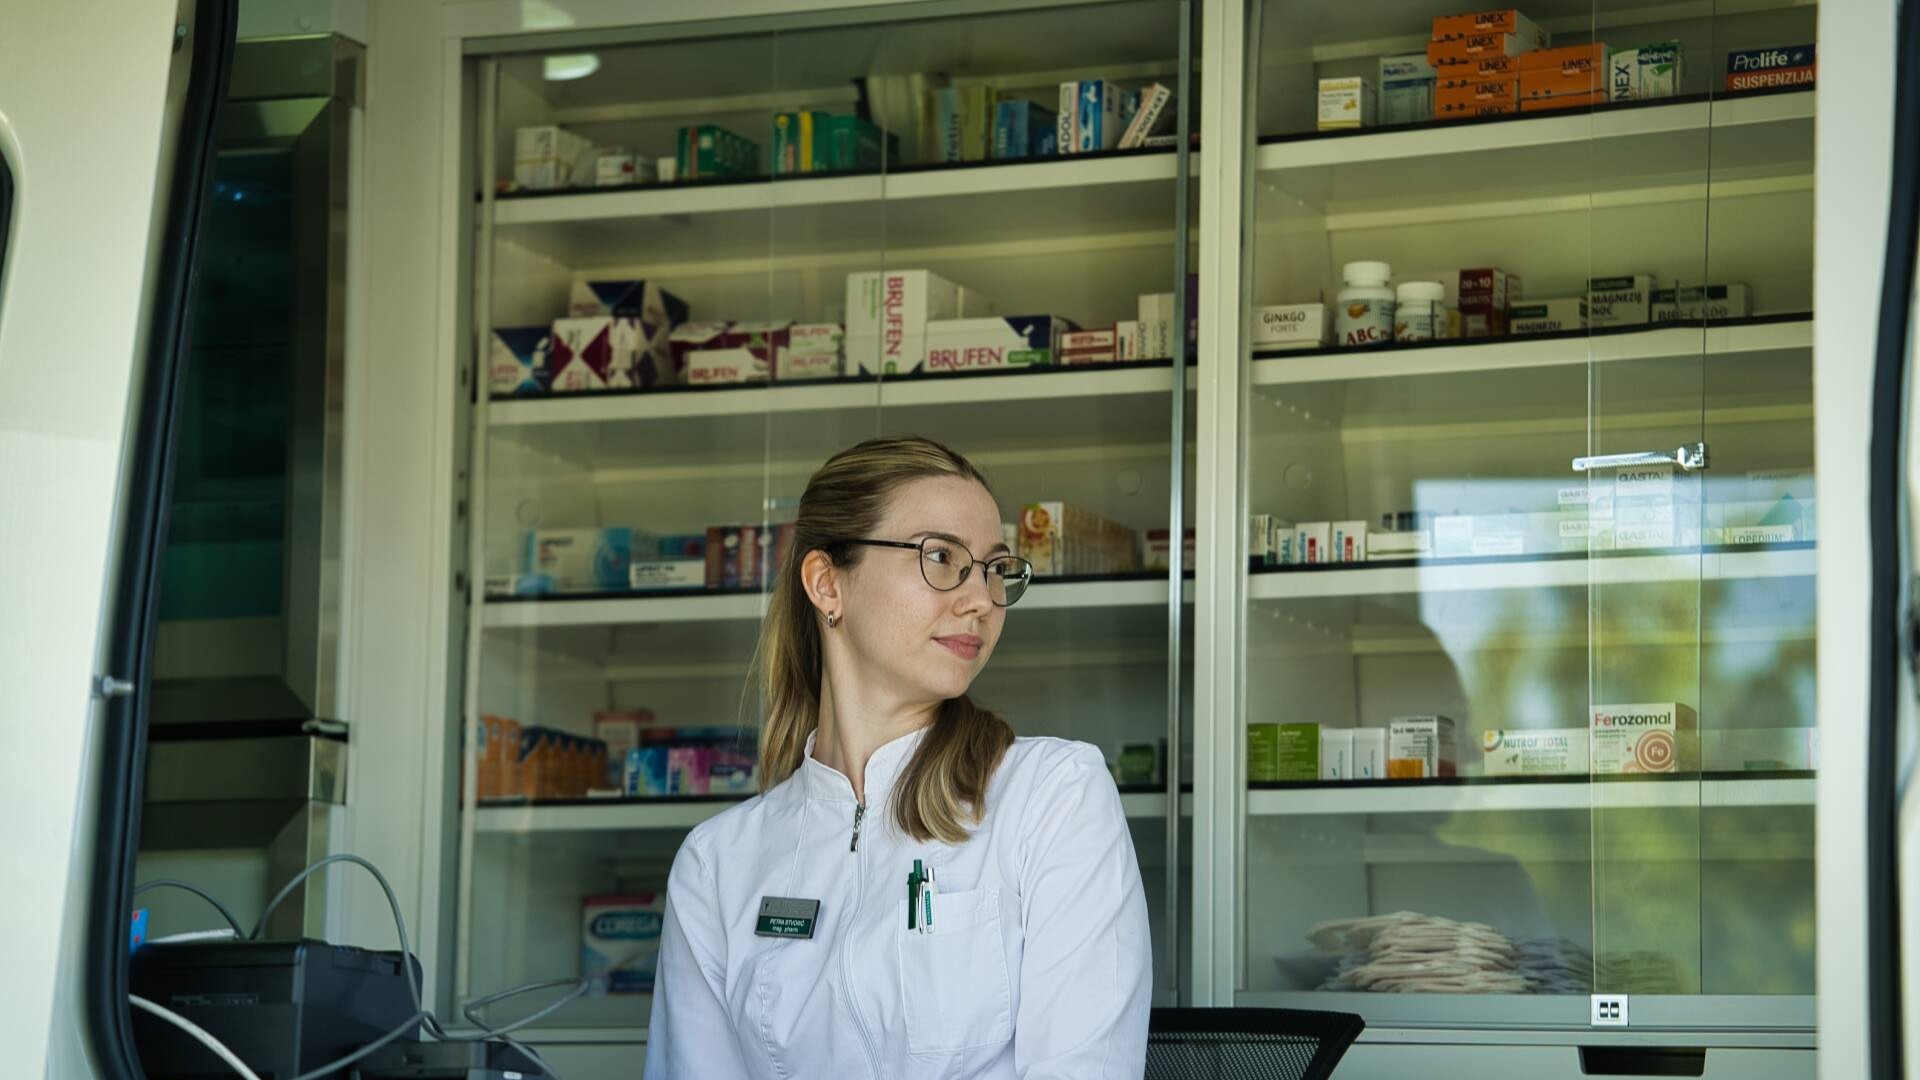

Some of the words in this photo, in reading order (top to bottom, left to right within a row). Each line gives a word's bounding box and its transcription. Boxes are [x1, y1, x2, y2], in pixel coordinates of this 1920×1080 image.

[1475, 13, 1505, 25] LINEX
[1466, 36, 1495, 48] LINEX
[1479, 60, 1509, 71] LINEX
[1562, 57, 1592, 70] LINEX
[1733, 51, 1788, 71] Prolife
[1733, 72, 1814, 90] SUSPENZIJA
[1475, 83, 1505, 95] LINEX
[883, 276, 904, 357] BRUFEN
[1263, 311, 1306, 324] GINKGO
[1271, 323, 1299, 333] FORTE
[1346, 326, 1377, 345] ABC
[929, 347, 1002, 371] BRUFEN
[1594, 711, 1671, 727] Ferozomal
[1503, 737, 1538, 749] NUTROF
[1543, 736, 1569, 748] TOTAL
[1651, 746, 1664, 757] Fe
